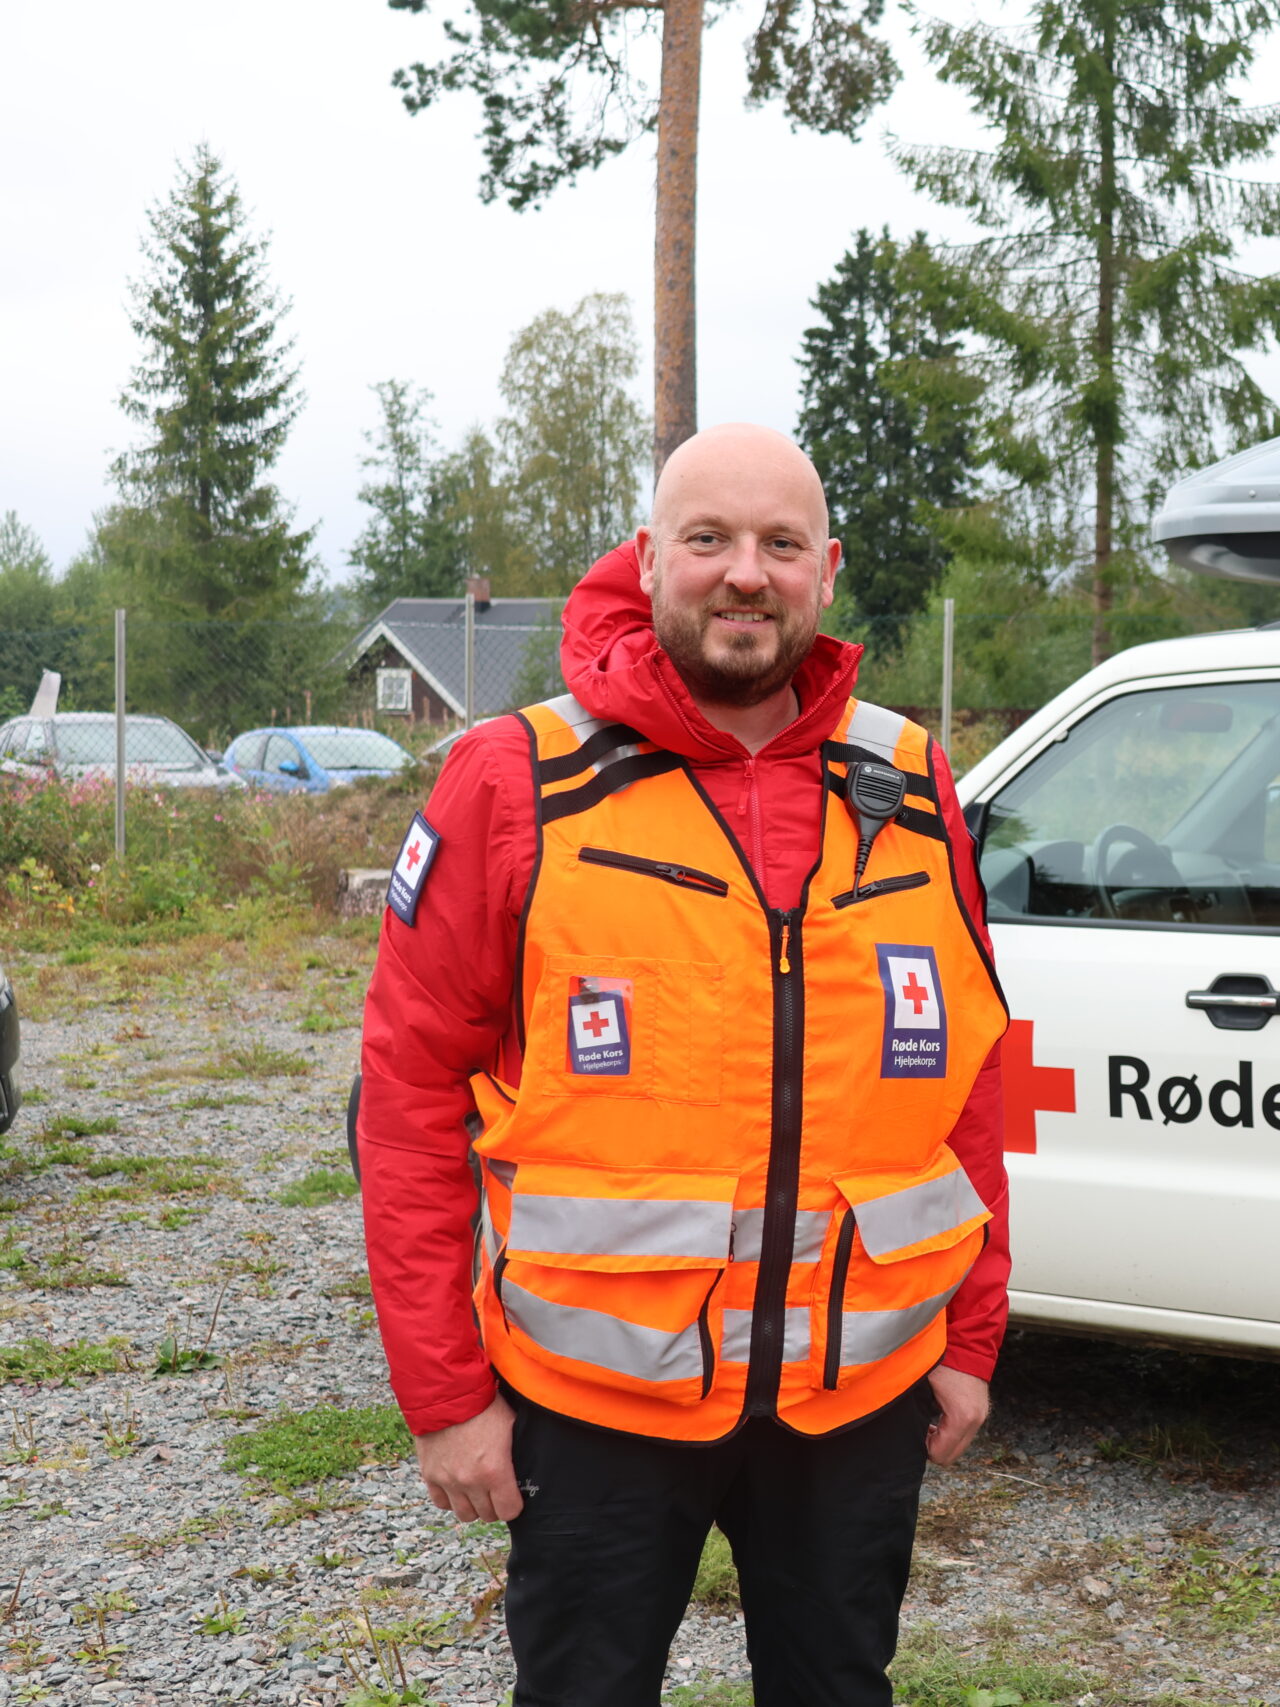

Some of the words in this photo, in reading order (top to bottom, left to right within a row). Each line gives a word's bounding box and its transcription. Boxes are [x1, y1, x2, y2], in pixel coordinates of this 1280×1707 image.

[892, 1038, 918, 1052] Røde
[919, 1038, 941, 1052] Kors
[578, 1052, 602, 1063] Røde
[602, 1049, 624, 1059] Kors
[894, 1055, 937, 1068] Hjelpekorps
[583, 1059, 622, 1072] Hjelpekorps
